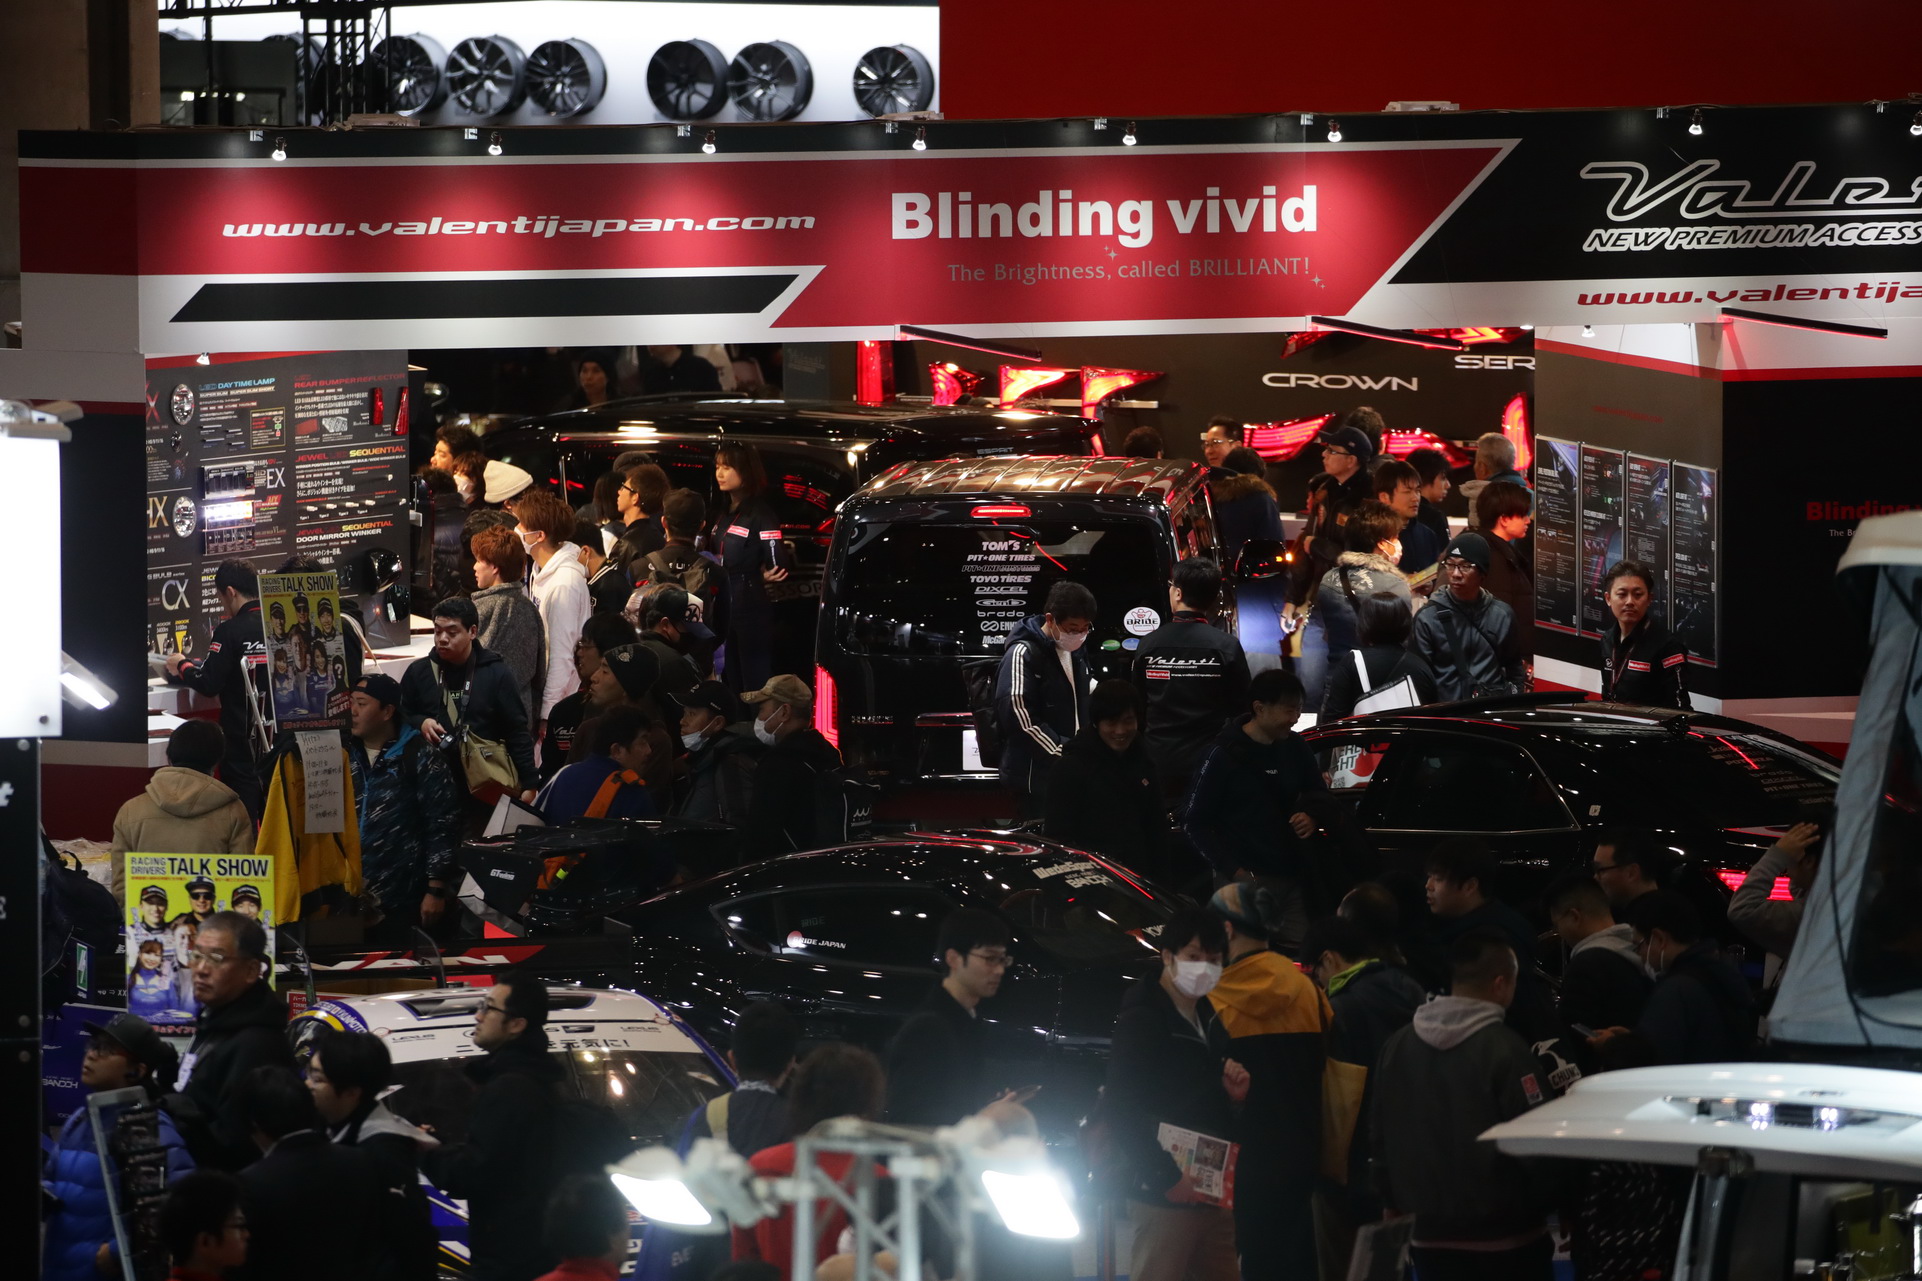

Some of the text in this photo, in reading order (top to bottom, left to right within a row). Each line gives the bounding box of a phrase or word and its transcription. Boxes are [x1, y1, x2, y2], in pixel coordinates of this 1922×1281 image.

[891, 184, 1318, 249] Blinding vivid
[222, 215, 816, 238] www.valentijapan.com
[1584, 229, 1670, 252] NEW
[1665, 225, 1816, 250] PREMIUM
[947, 257, 1310, 286] The Brightness, called BRILLIANT!
[217, 381, 233, 389] DAY
[233, 380, 253, 388] TIME
[253, 378, 276, 386] LAMP
[1262, 372, 1419, 392] CROWN
[295, 453, 328, 463] JEWEL
[349, 446, 406, 458] SEQUENTIAL
[266, 467, 286, 489] EX
[342, 521, 394, 532] SEQUENTIAL
[1829, 529, 1845, 538] The
[319, 532, 350, 541] MIRROR
[350, 529, 382, 538] WINKER
[981, 540, 1021, 551] TOM'S
[280, 576, 306, 592] TALK
[307, 575, 334, 591] SHOW
[970, 574, 1033, 583] TOYO TIRES
[162, 579, 190, 611] CX
[974, 585, 1028, 595] DIXCEL
[1144, 655, 1221, 666] Valenti
[130, 856, 269, 878] RACING TALK SHOW
[131, 866, 166, 876] DRIVERS
[818, 940, 847, 949] JAPAN
